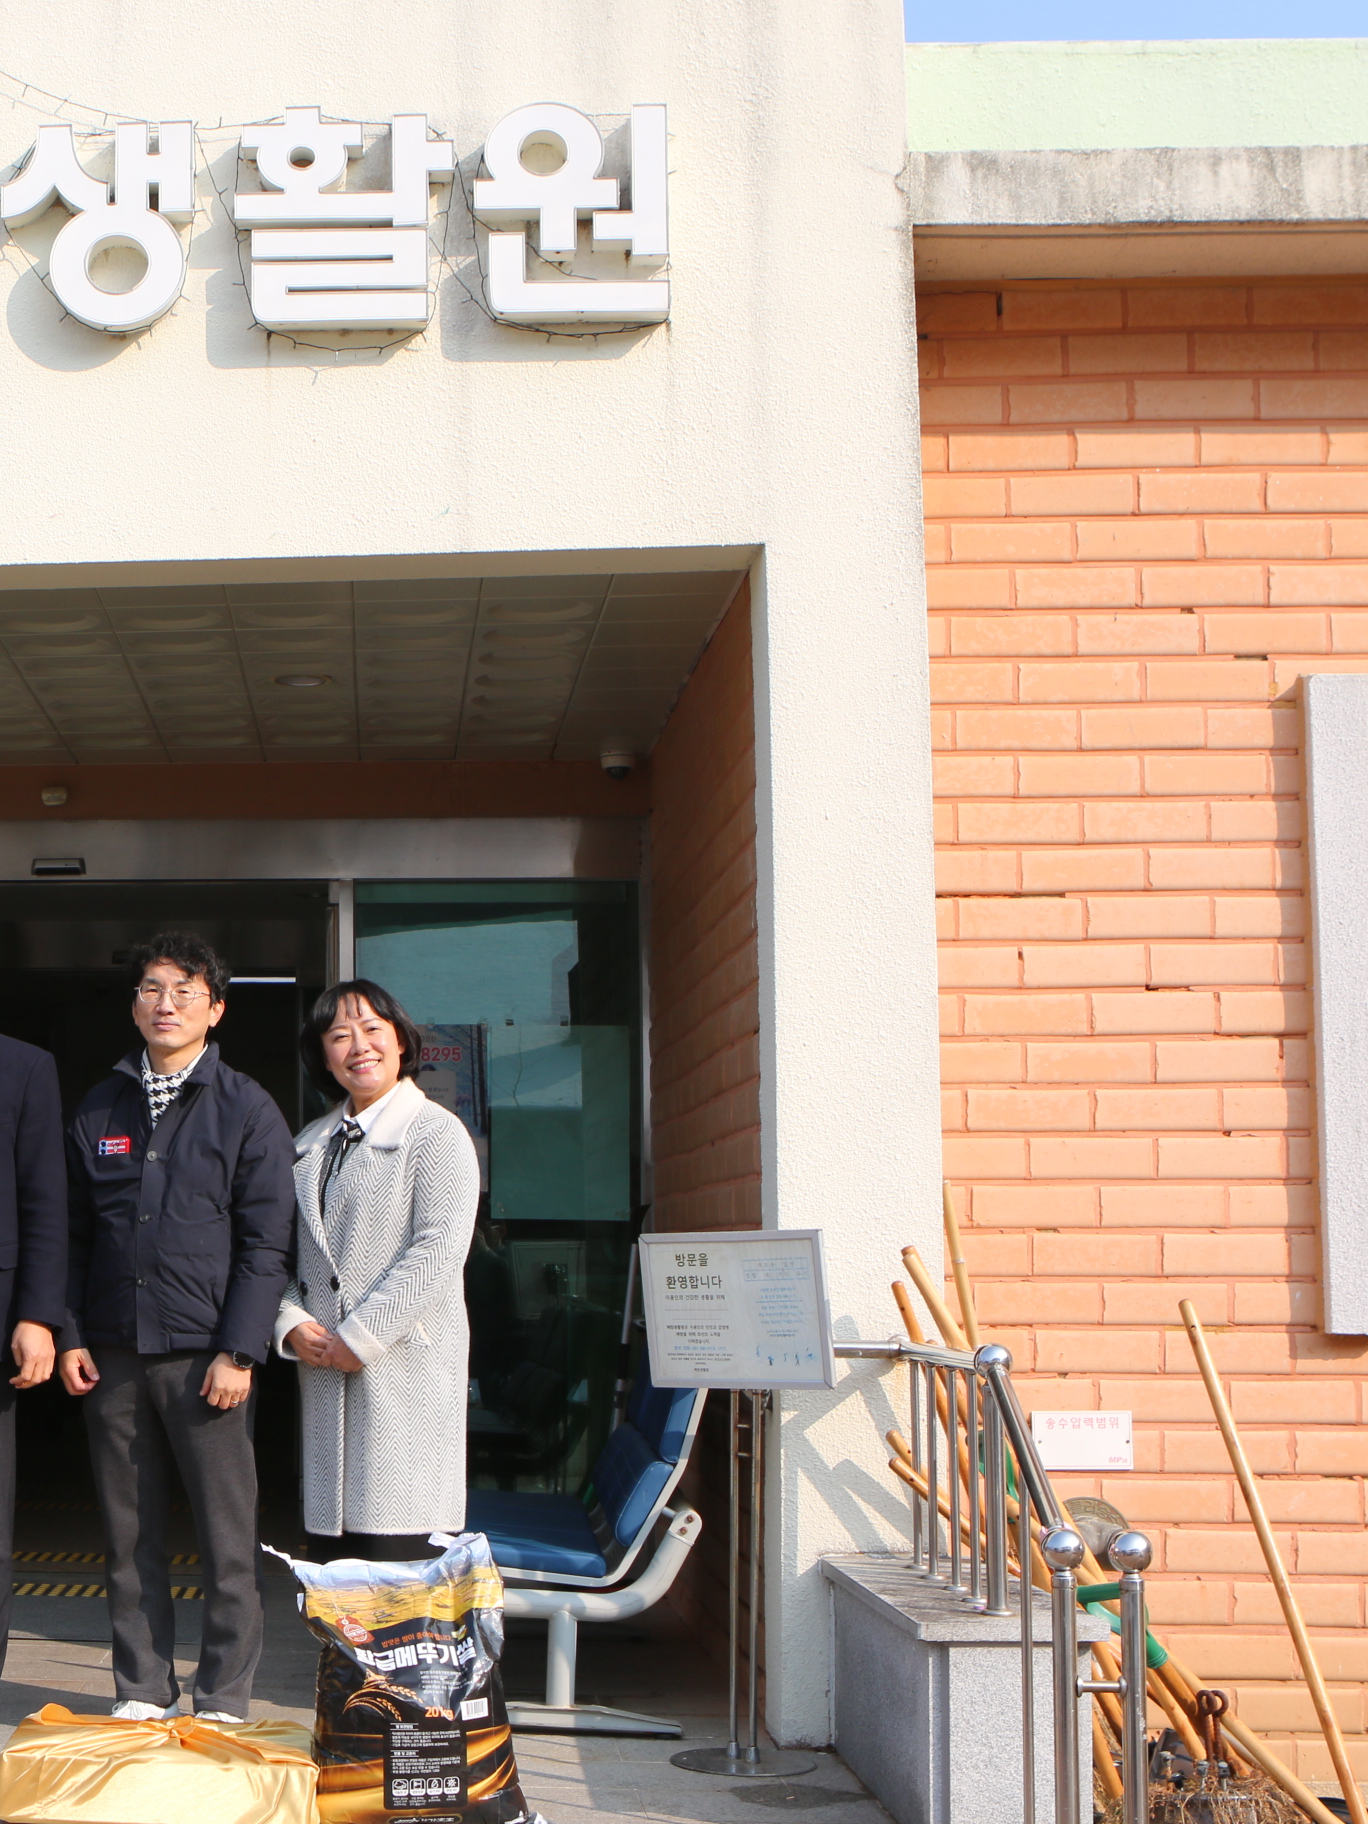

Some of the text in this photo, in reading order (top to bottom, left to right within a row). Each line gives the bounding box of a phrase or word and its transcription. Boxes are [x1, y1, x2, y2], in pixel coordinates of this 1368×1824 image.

[675, 1252, 709, 1267] 방문을
[665, 1274, 722, 1289] 환영합니다
[1045, 1416, 1120, 1430] 송수압력범위
[1108, 1456, 1128, 1464] MPa
